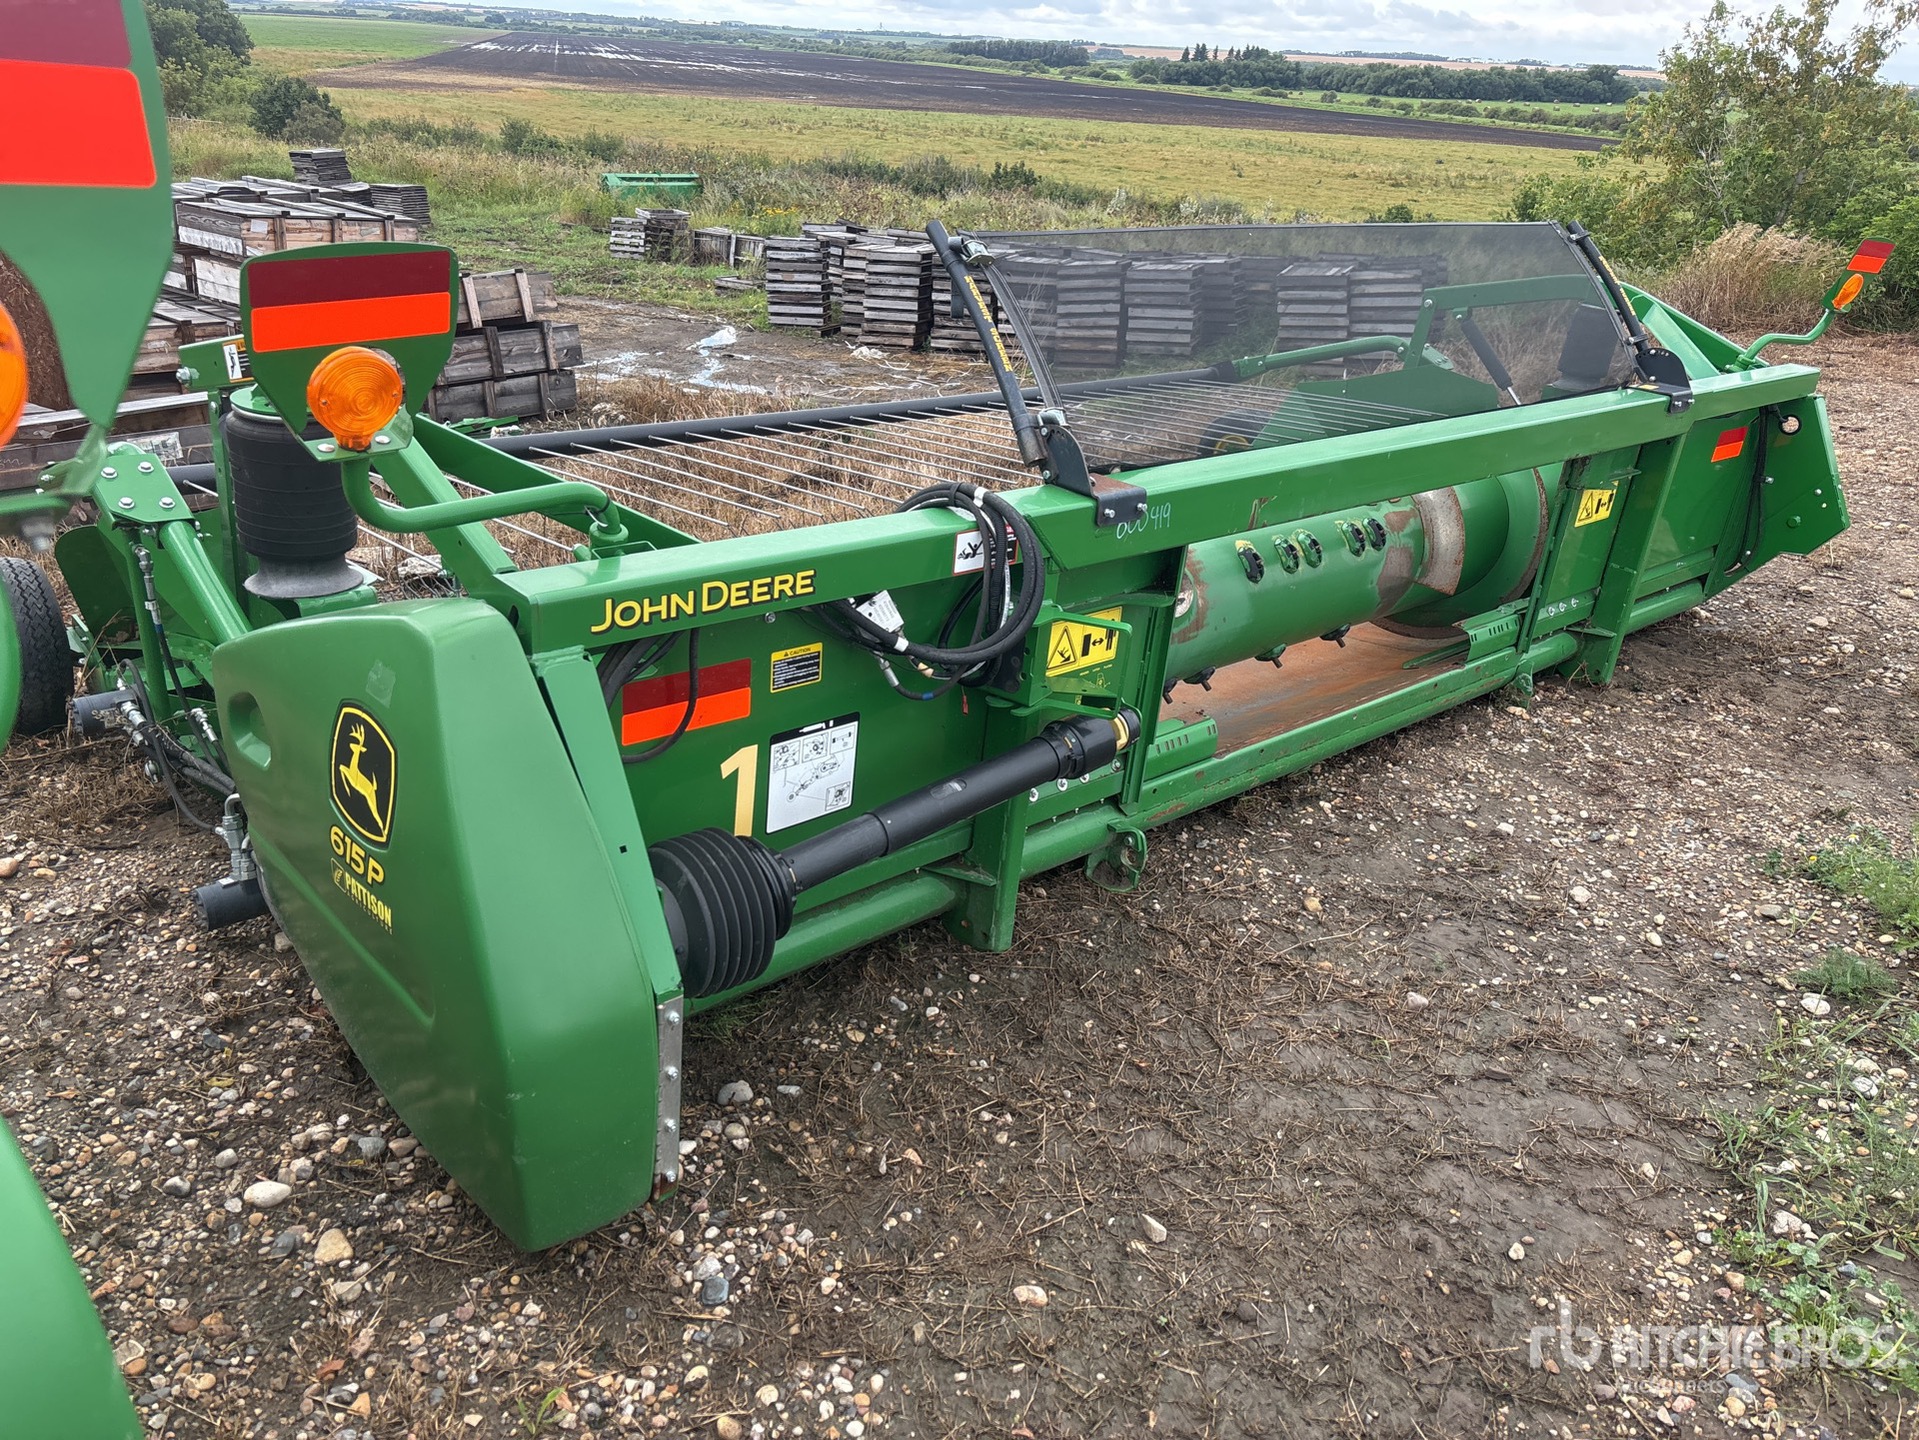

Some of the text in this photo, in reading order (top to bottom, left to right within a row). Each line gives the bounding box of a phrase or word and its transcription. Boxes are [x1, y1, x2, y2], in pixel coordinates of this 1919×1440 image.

[990, 327, 1014, 372] SCREEN
[591, 569, 816, 634] JOHN DEERE
[789, 647, 812, 656] CAUTION
[720, 744, 759, 837] 1
[330, 825, 385, 885] 615P
[345, 871, 392, 927] PATTISON
